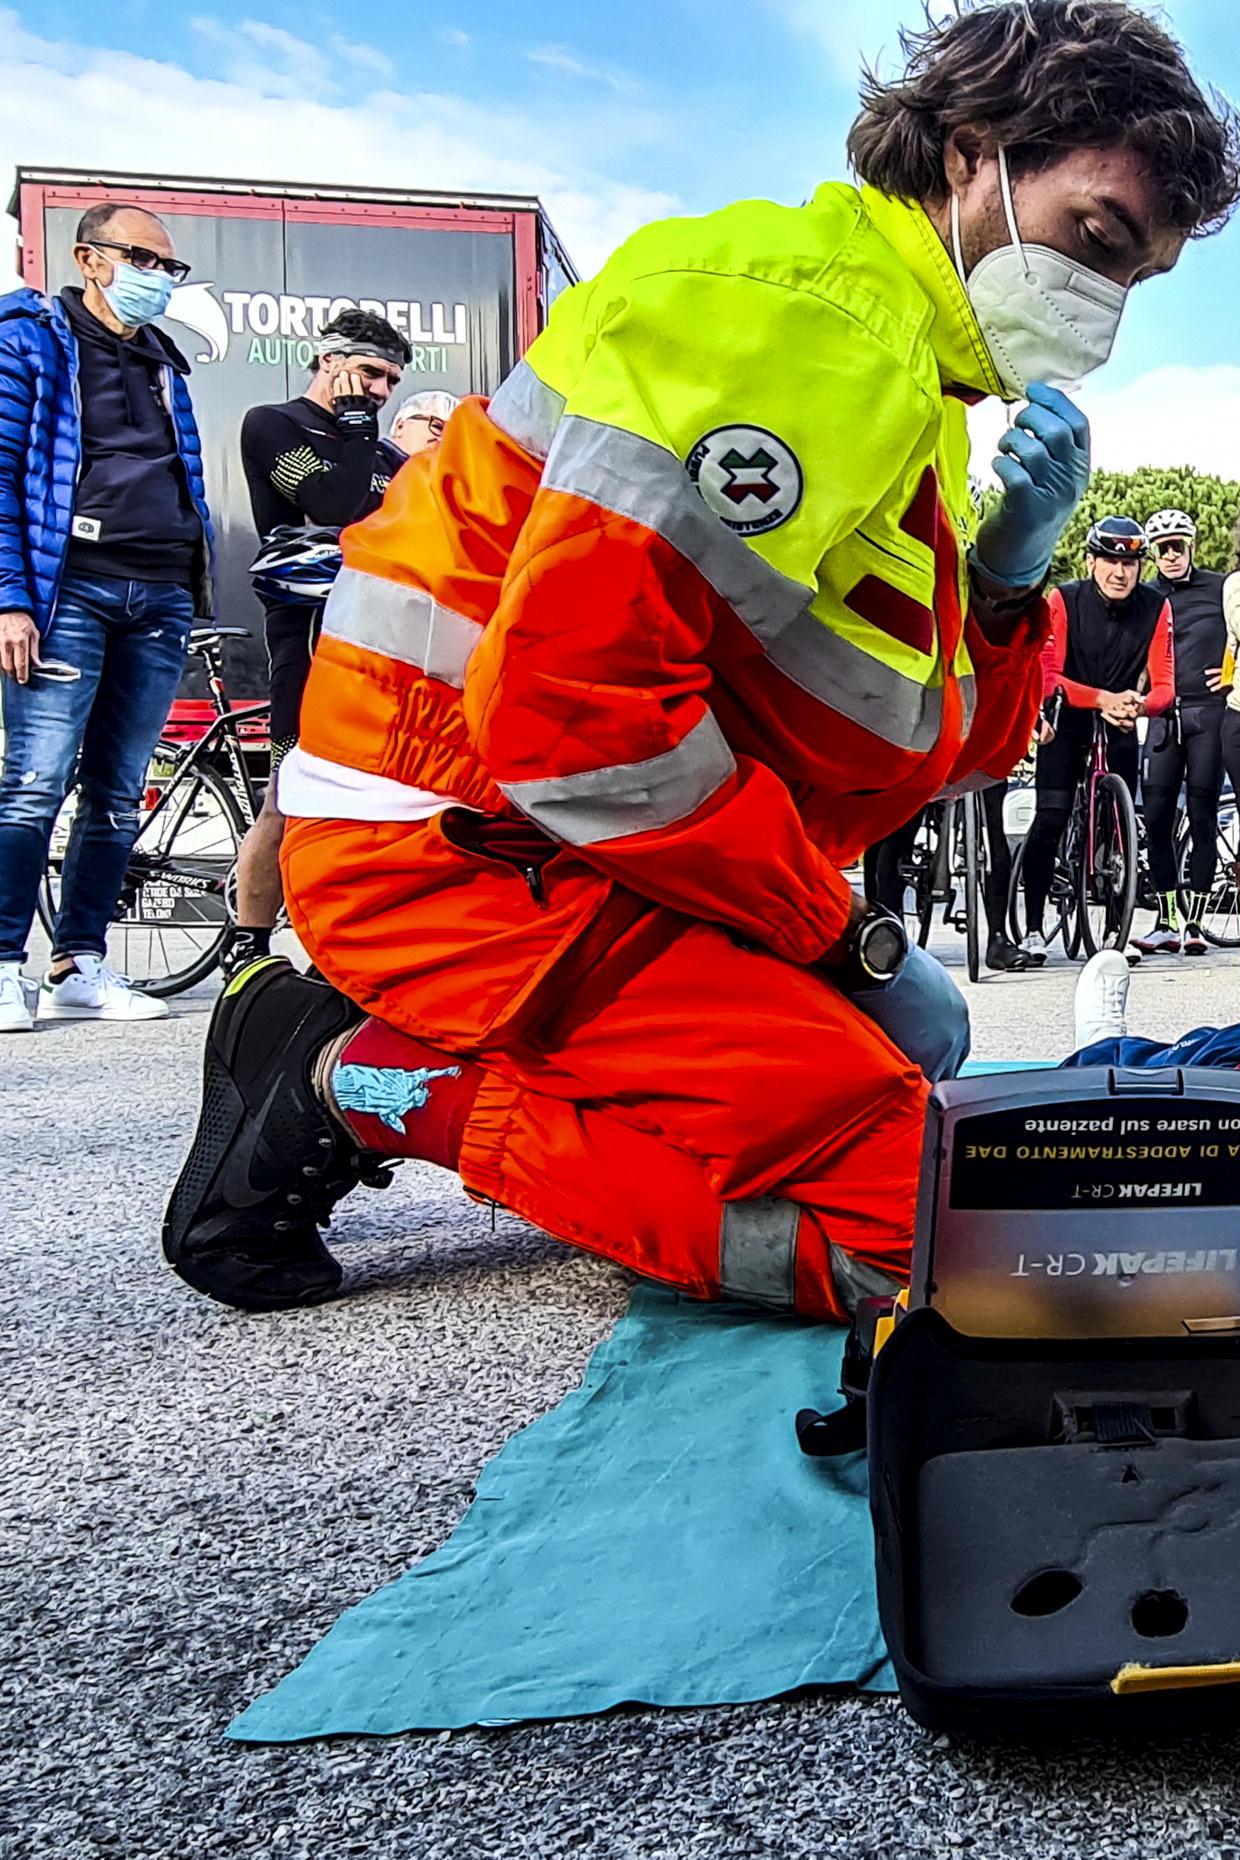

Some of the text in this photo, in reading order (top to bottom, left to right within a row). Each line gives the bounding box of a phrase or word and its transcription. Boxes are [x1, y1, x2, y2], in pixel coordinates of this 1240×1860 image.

[248, 337, 448, 374] AUTORTI
[1025, 1118, 1113, 1136] paziente
[1120, 1118, 1149, 1134] sul
[1156, 1118, 1211, 1134] usare
[965, 1145, 1007, 1159] DAE
[1016, 1144, 1193, 1159] ADDESTRAMENTO
[1200, 1144, 1219, 1158] DI
[1071, 1182, 1202, 1198] LIFEPAK CR-T
[1010, 1248, 1239, 1277] LIFEPAK CR-T
